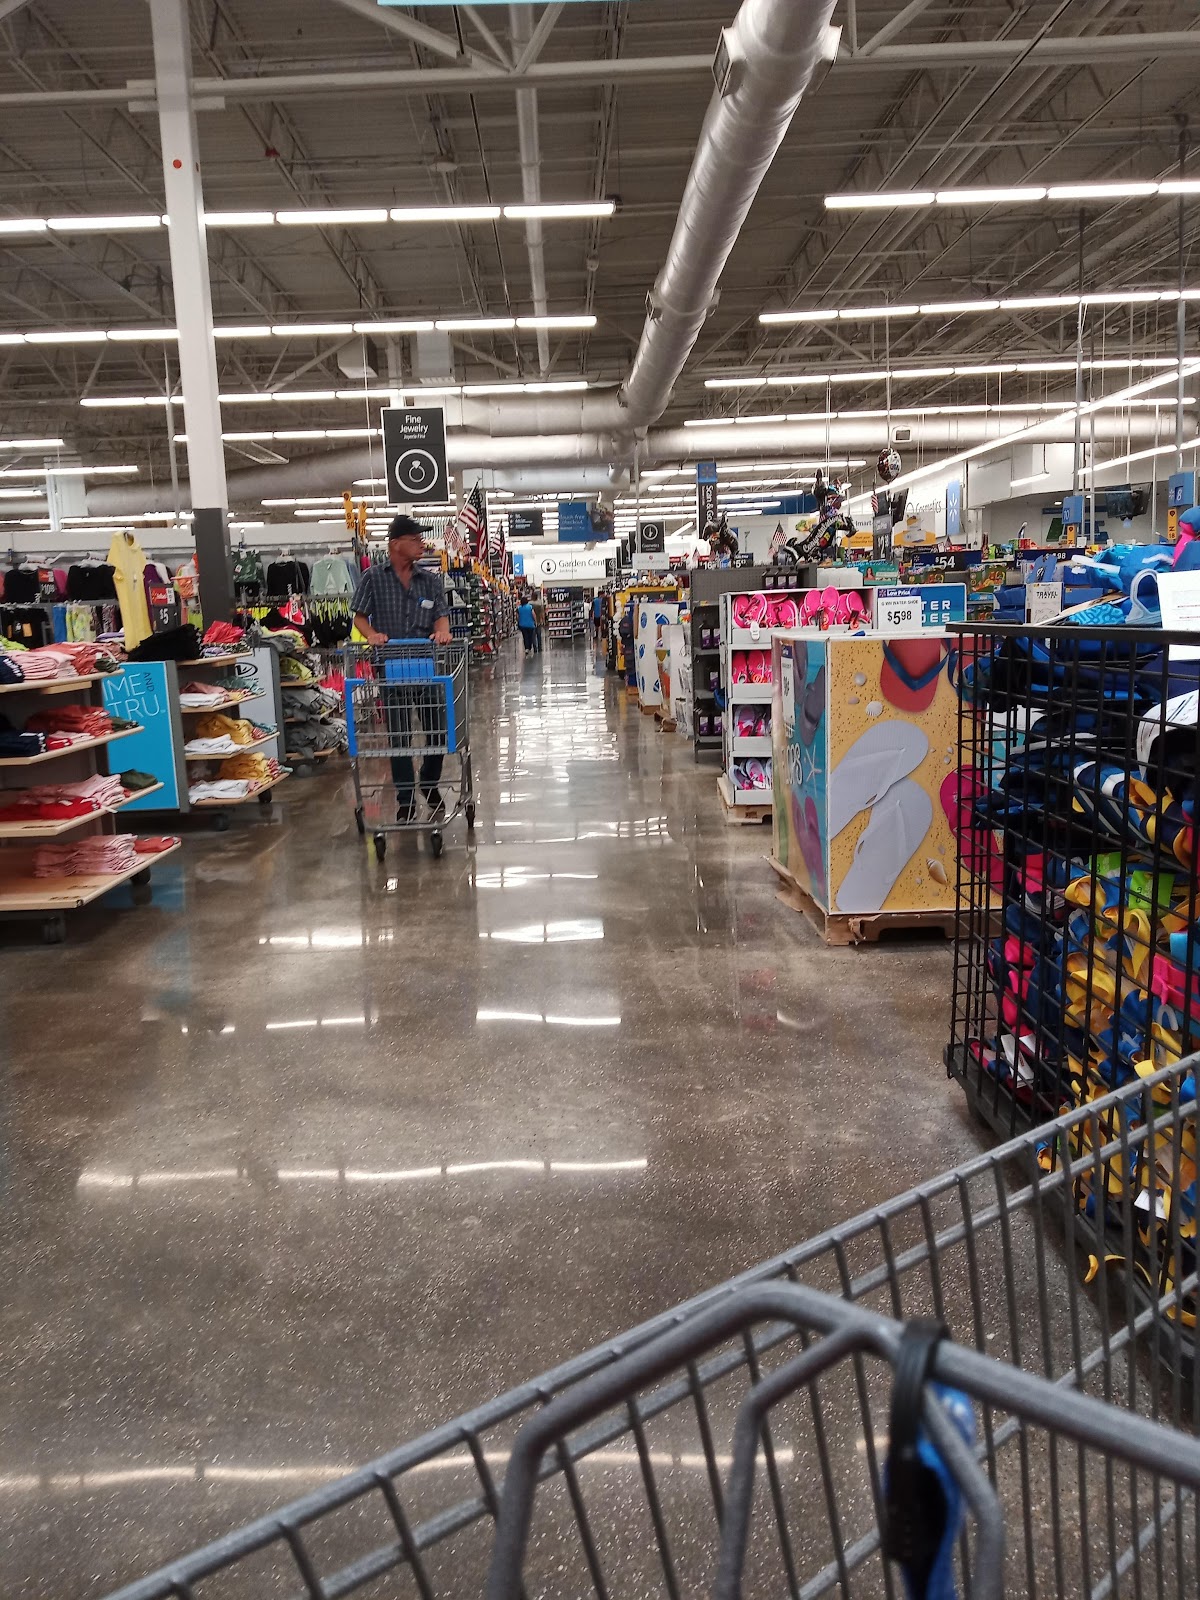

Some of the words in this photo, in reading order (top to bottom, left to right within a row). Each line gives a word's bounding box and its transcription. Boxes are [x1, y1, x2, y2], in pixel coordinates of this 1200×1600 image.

[405, 414, 422, 424] Fine
[399, 423, 429, 435] Jewelry
[706, 485, 714, 503] Scan
[1176, 488, 1183, 501] 8
[558, 558, 587, 568] Garden
[935, 555, 956, 570] $54
[160, 608, 169, 625] $5
